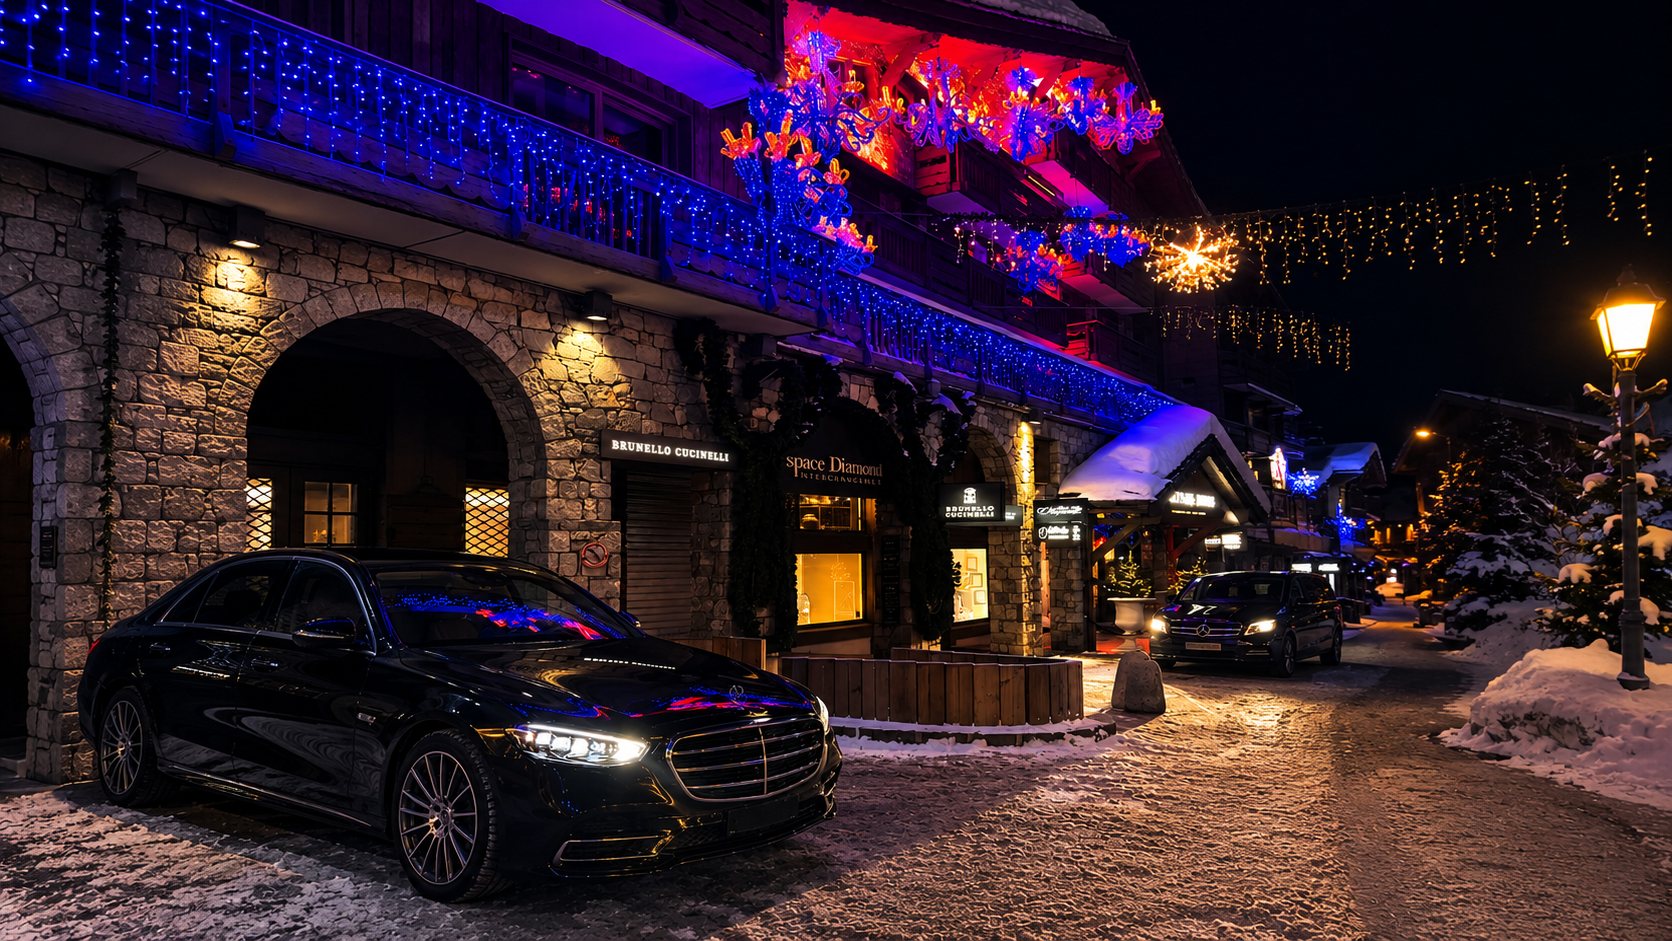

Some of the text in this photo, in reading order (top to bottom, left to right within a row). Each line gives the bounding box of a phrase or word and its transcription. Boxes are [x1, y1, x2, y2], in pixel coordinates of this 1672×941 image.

[611, 439, 730, 462] BRUNELLO CUCINELLI
[786, 455, 883, 478] space Diamond
